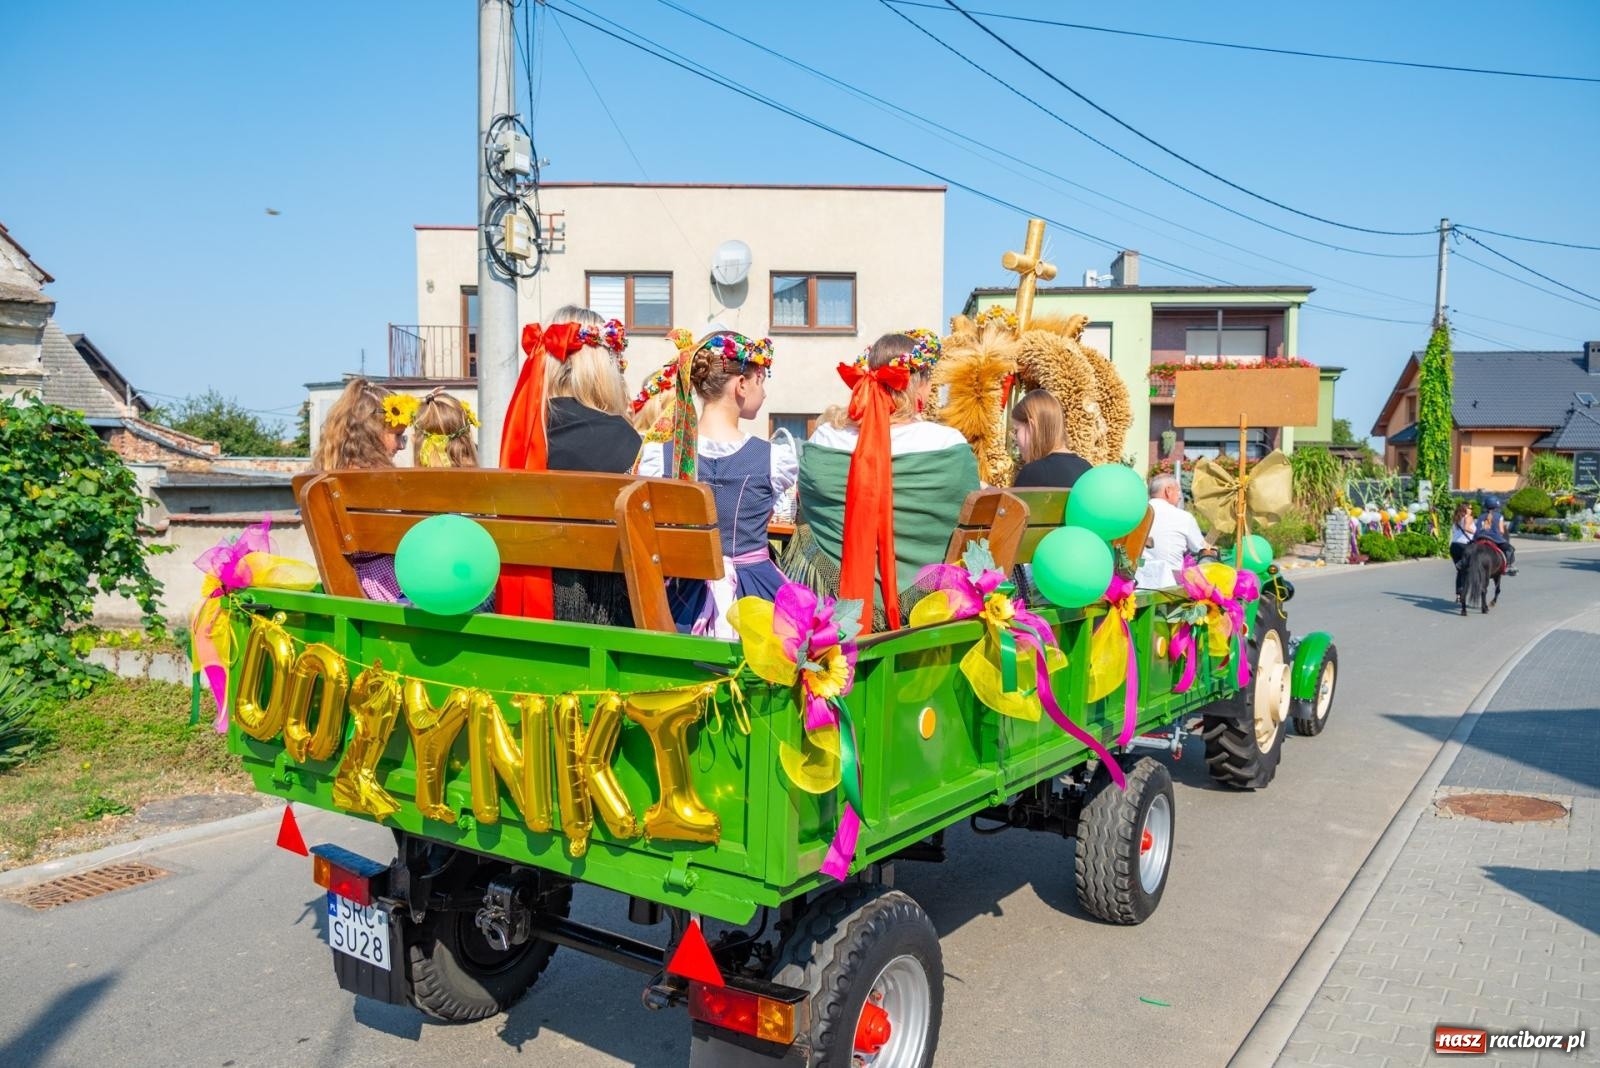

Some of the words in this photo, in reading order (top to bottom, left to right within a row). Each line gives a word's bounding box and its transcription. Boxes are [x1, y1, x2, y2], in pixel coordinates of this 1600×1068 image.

[329, 903, 337, 912] PL
[341, 897, 375, 929] SRC
[334, 921, 383, 963] SU28
